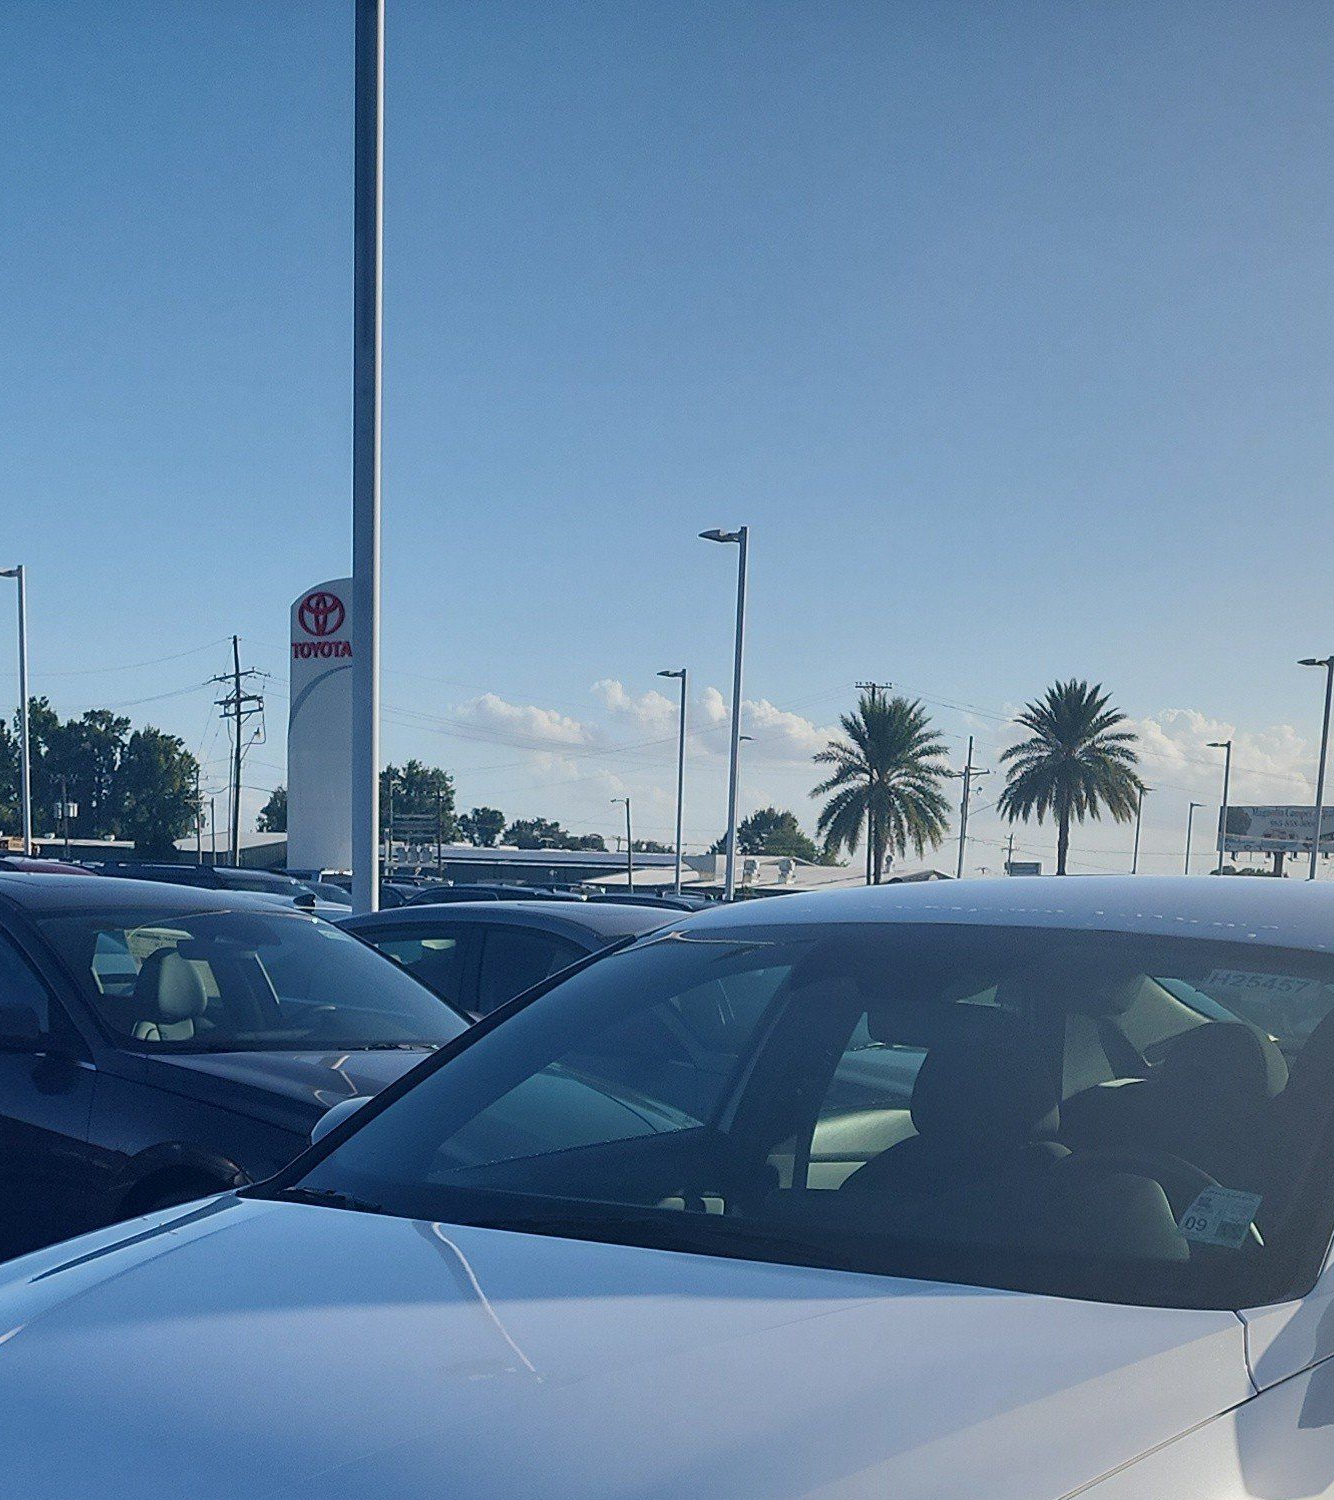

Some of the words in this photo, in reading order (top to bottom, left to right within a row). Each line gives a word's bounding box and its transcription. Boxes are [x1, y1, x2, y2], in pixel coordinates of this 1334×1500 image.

[291, 641, 353, 659] TOYOTA
[1208, 973, 1310, 993] H25457
[1185, 1216, 1207, 1231] 09
